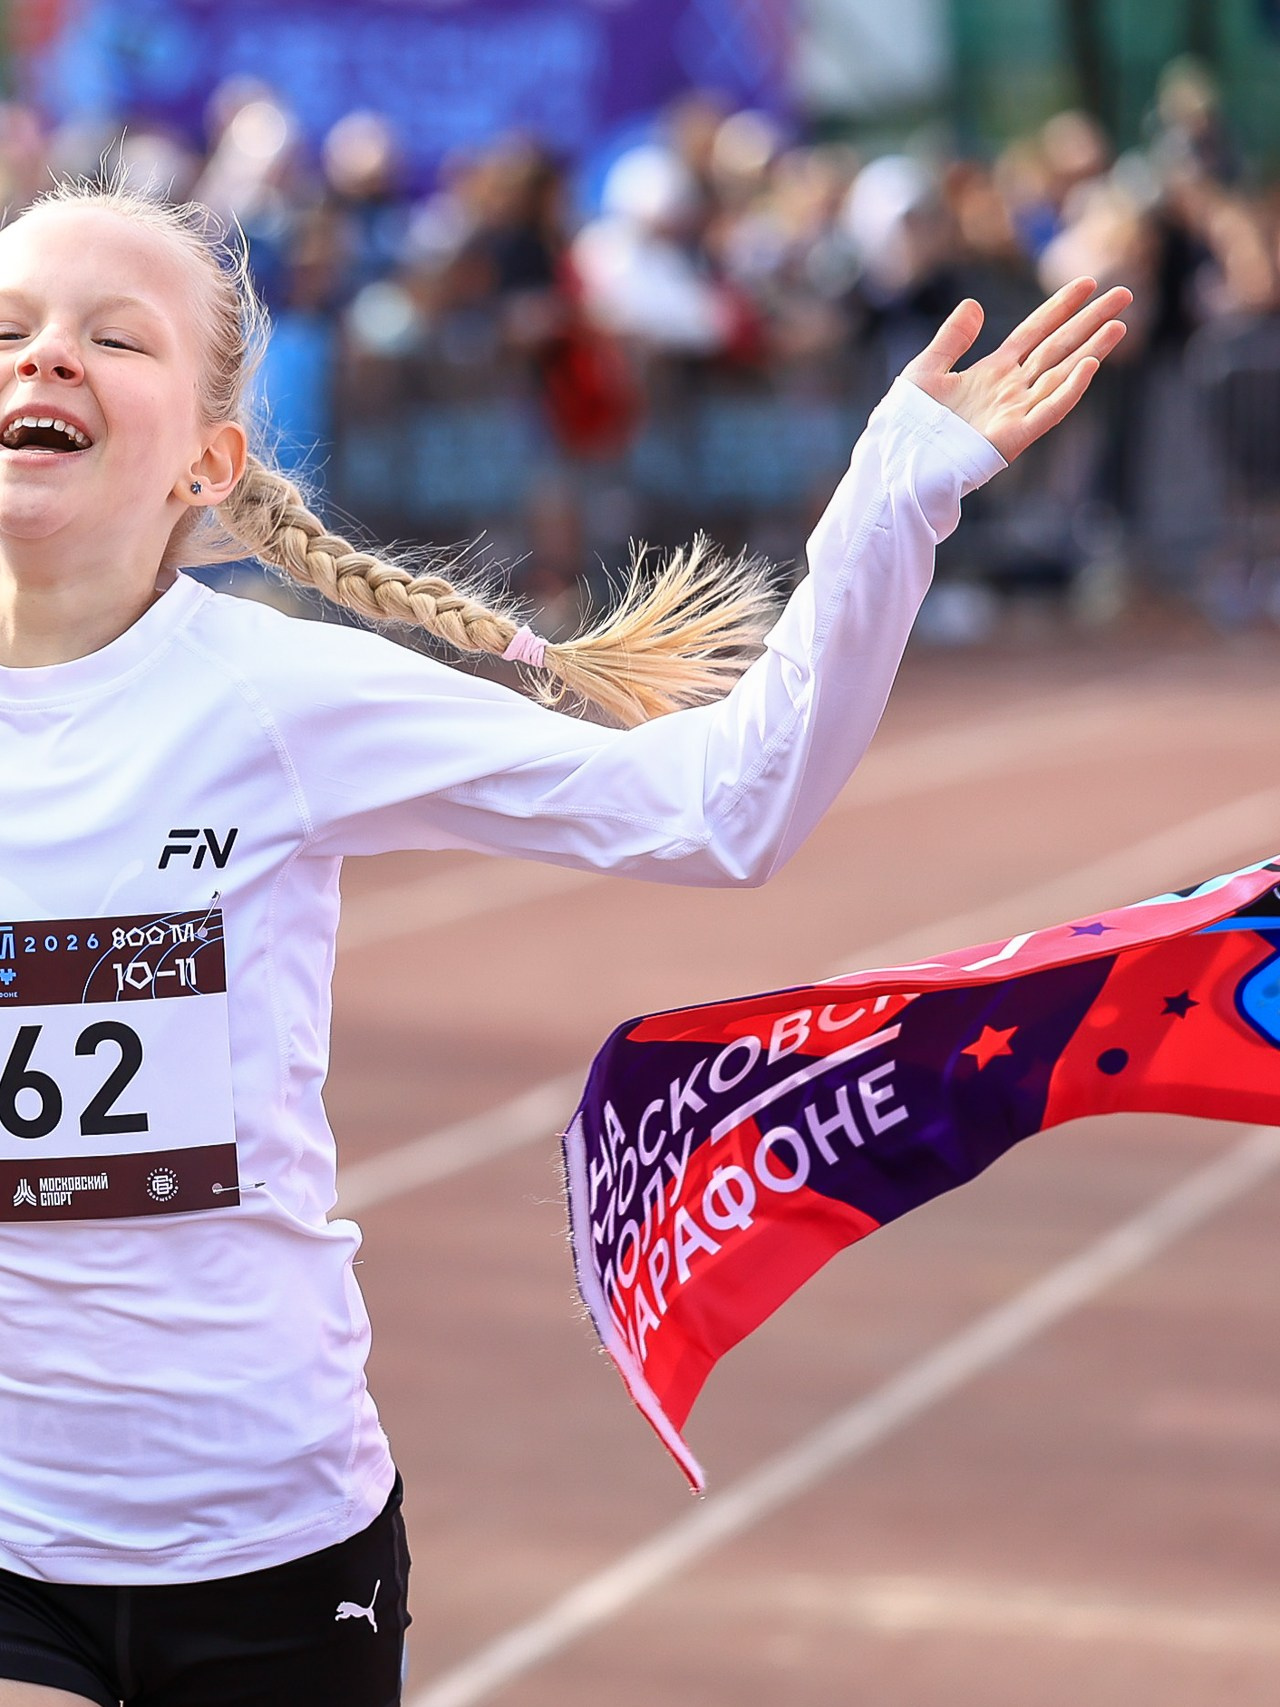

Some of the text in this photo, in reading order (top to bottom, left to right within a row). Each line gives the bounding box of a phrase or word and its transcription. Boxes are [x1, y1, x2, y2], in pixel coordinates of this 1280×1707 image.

[158, 828, 238, 869] FN
[24, 933, 99, 953] 2026
[589, 1100, 626, 1214] НА
[39, 1172, 109, 1191] МОСКОВСКИЙ
[40, 1191, 72, 1206] СПОРТ
